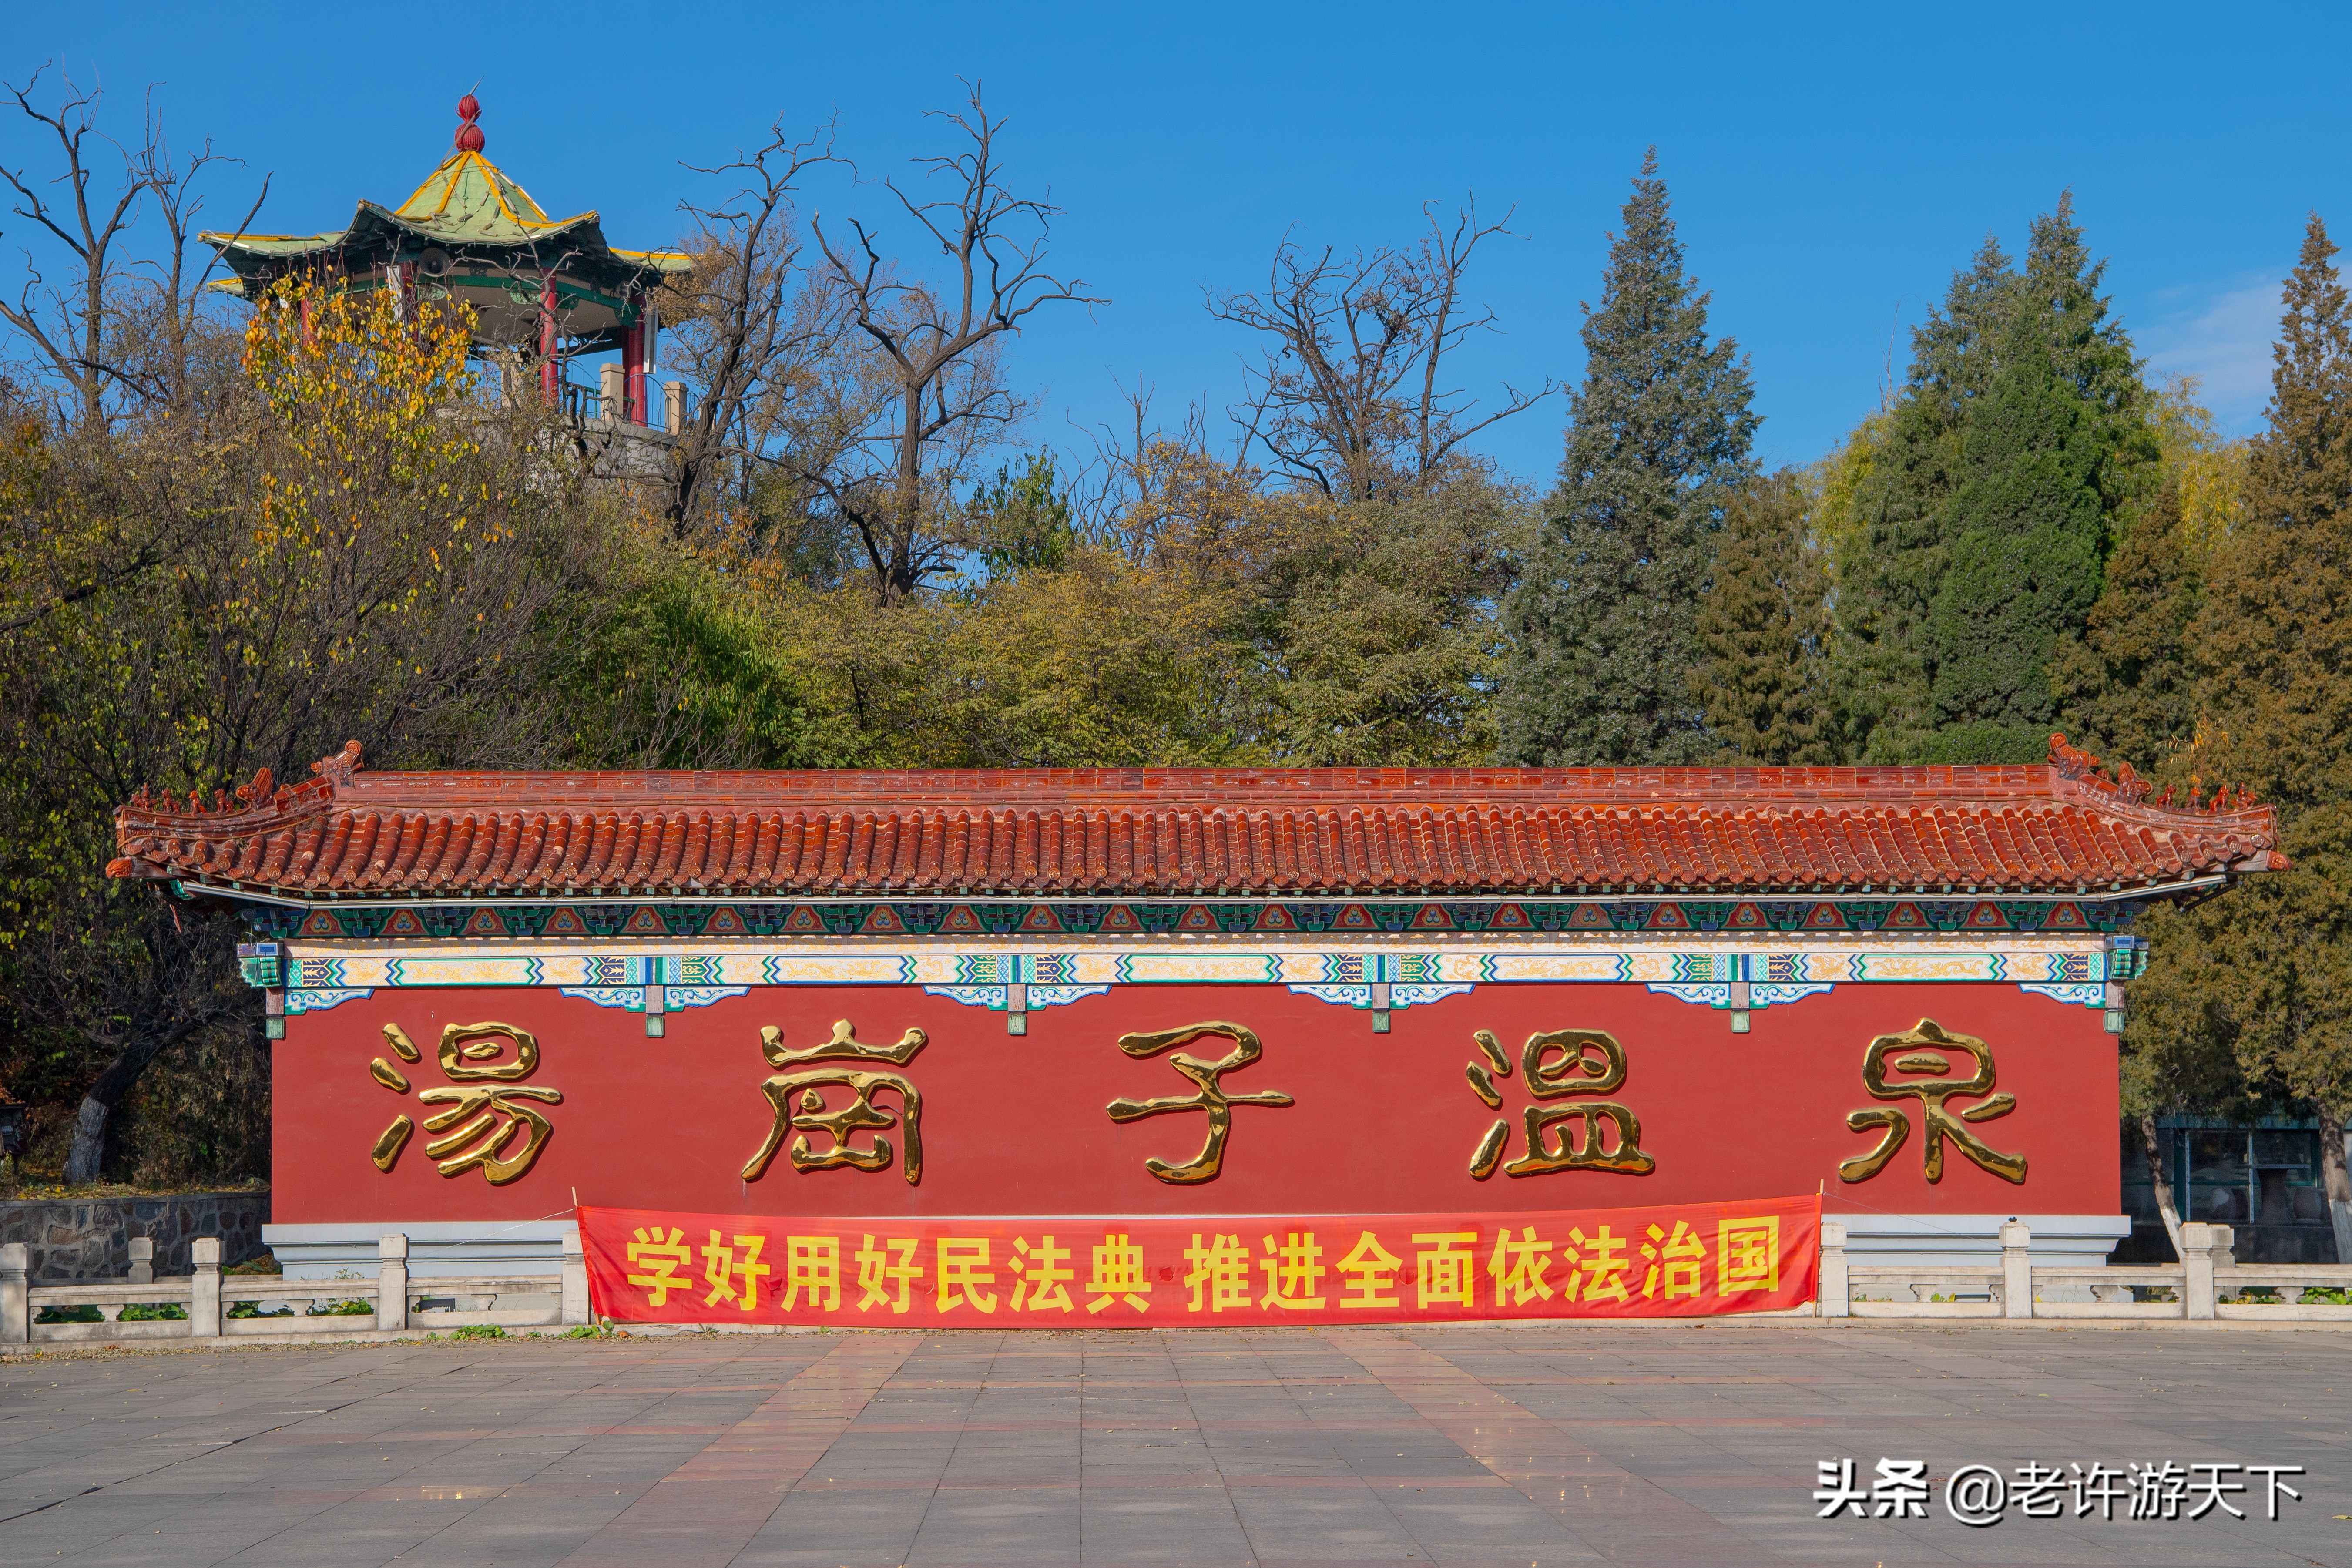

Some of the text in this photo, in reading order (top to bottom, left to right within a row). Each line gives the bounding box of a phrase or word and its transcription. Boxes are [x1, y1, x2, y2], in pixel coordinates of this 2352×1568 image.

[627, 1215, 1780, 1314] 学好用好民法典 推进全面依法治国
